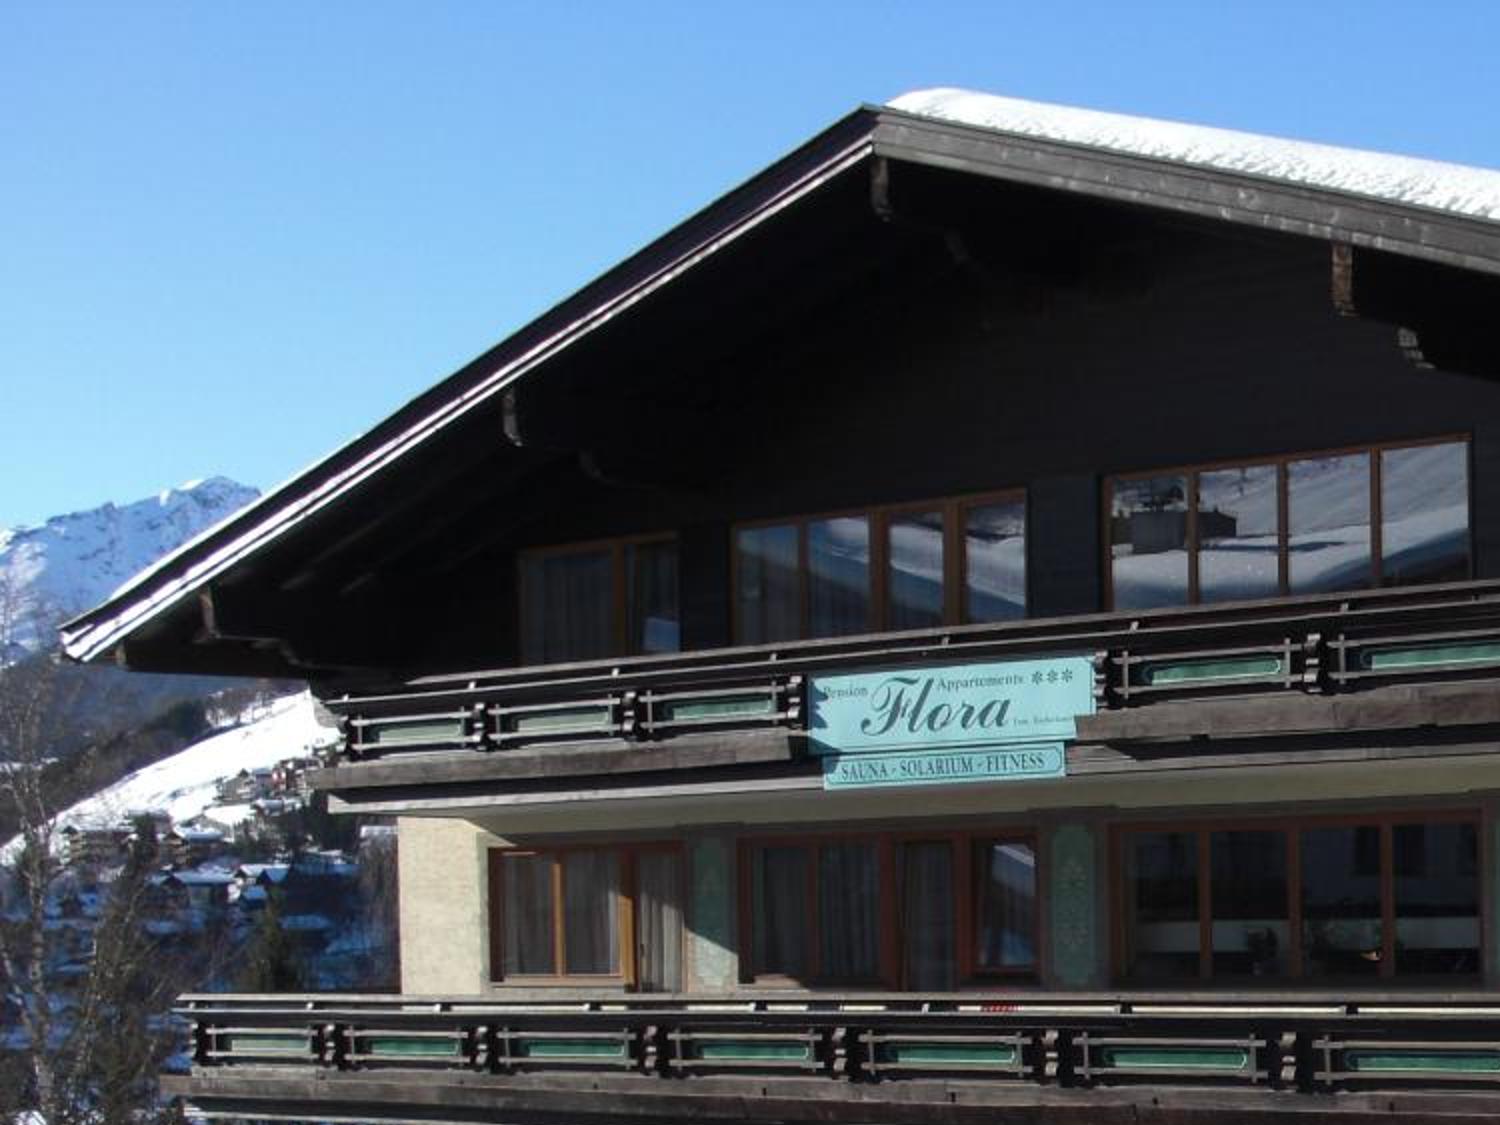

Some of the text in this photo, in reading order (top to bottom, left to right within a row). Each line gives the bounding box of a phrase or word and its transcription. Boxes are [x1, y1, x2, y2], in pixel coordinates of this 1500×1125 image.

[823, 684, 868, 699] Pension
[937, 674, 1023, 692] Appartements
[861, 677, 1010, 736] Flora
[842, 761, 887, 780] SAUNA
[900, 757, 973, 777] SOLARIUM
[986, 752, 1045, 772] FITNESS
